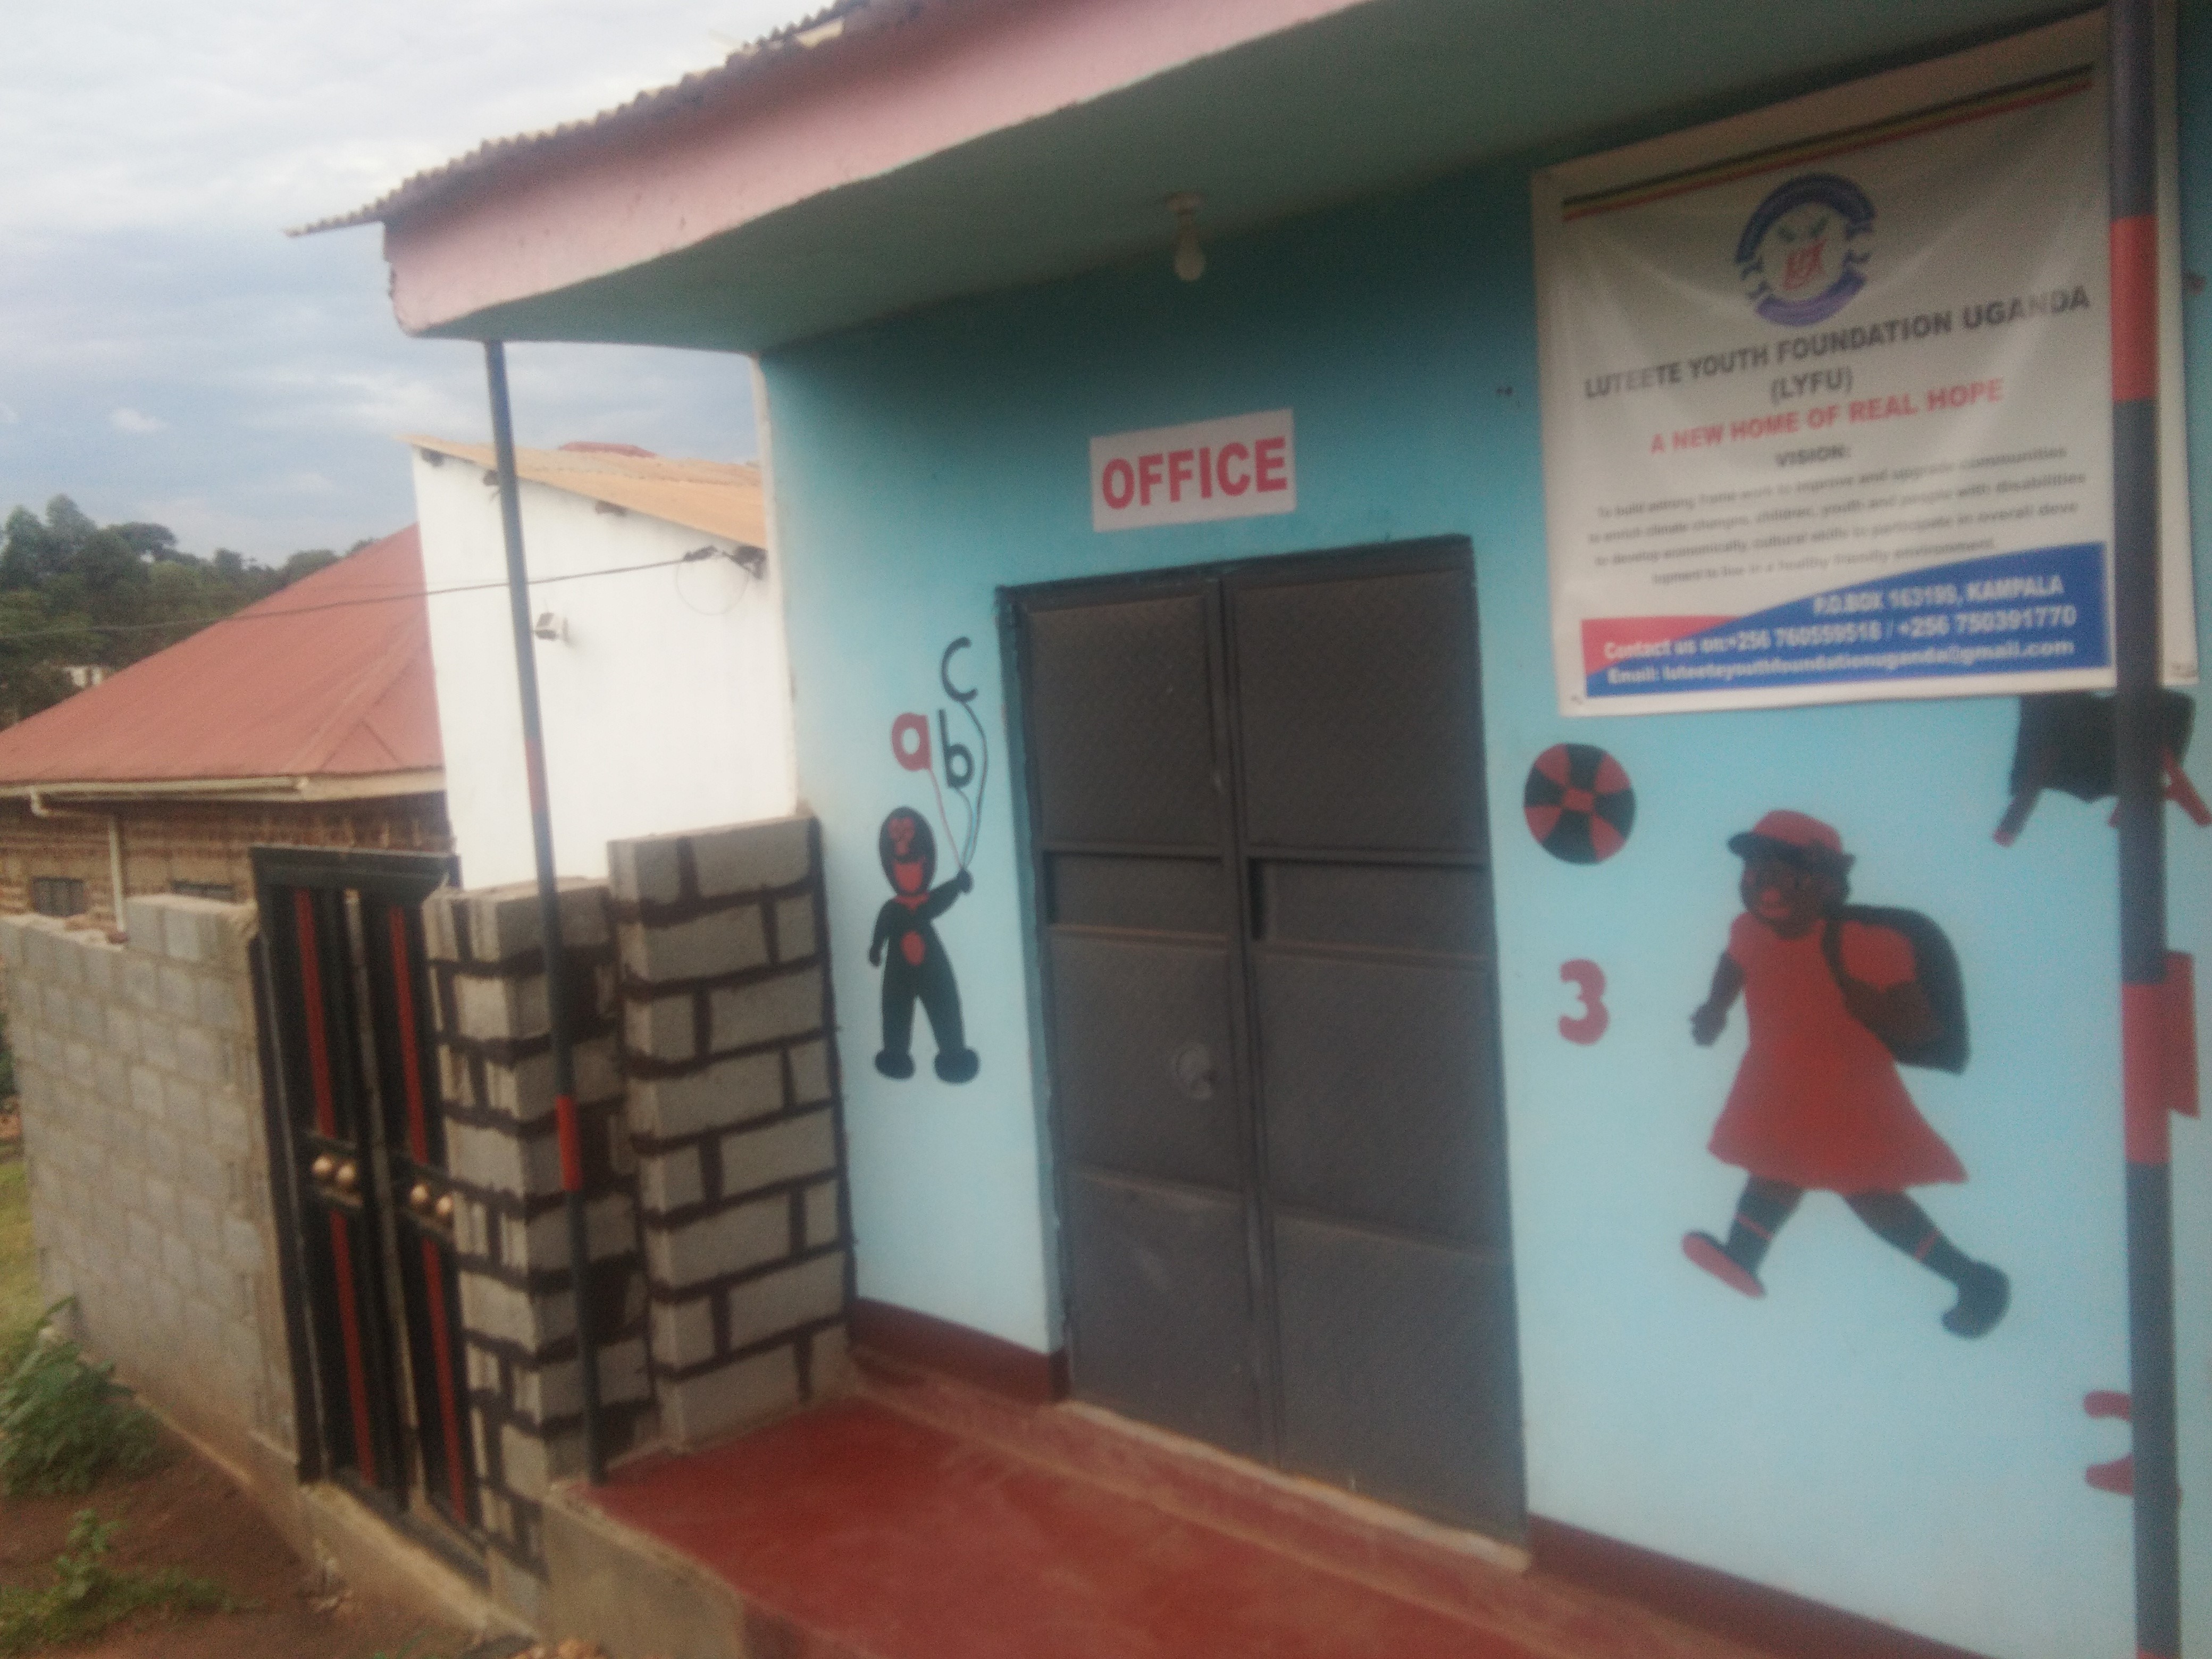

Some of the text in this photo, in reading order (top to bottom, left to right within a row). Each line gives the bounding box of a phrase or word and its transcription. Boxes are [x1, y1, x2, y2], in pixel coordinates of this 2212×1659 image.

[1585, 285, 2090, 398] LUTEETE YOUTH FOUNDATION UGANDA
[1771, 366, 1853, 405] (LYFU)
[1650, 378, 2004, 454] A NEW HOME OF REAL HOPE
[1101, 436, 1288, 510] OFFICE
[1774, 444, 1851, 468] VISION:
[1858, 470, 1888, 484] and
[1959, 446, 2067, 470] communities
[1868, 495, 1896, 509] and
[1956, 483, 1991, 497] with
[1995, 472, 2086, 493] disabilities
[1977, 504, 2034, 523] overall
[1966, 574, 2064, 601] KAMPALA
[1603, 640, 1671, 659] Contact
[1674, 640, 1696, 655] us
[1898, 614, 1949, 638] +256
[1955, 604, 2077, 634] 750391770
[1607, 667, 1657, 684] Email:
[1557, 957, 1611, 1046] 3
